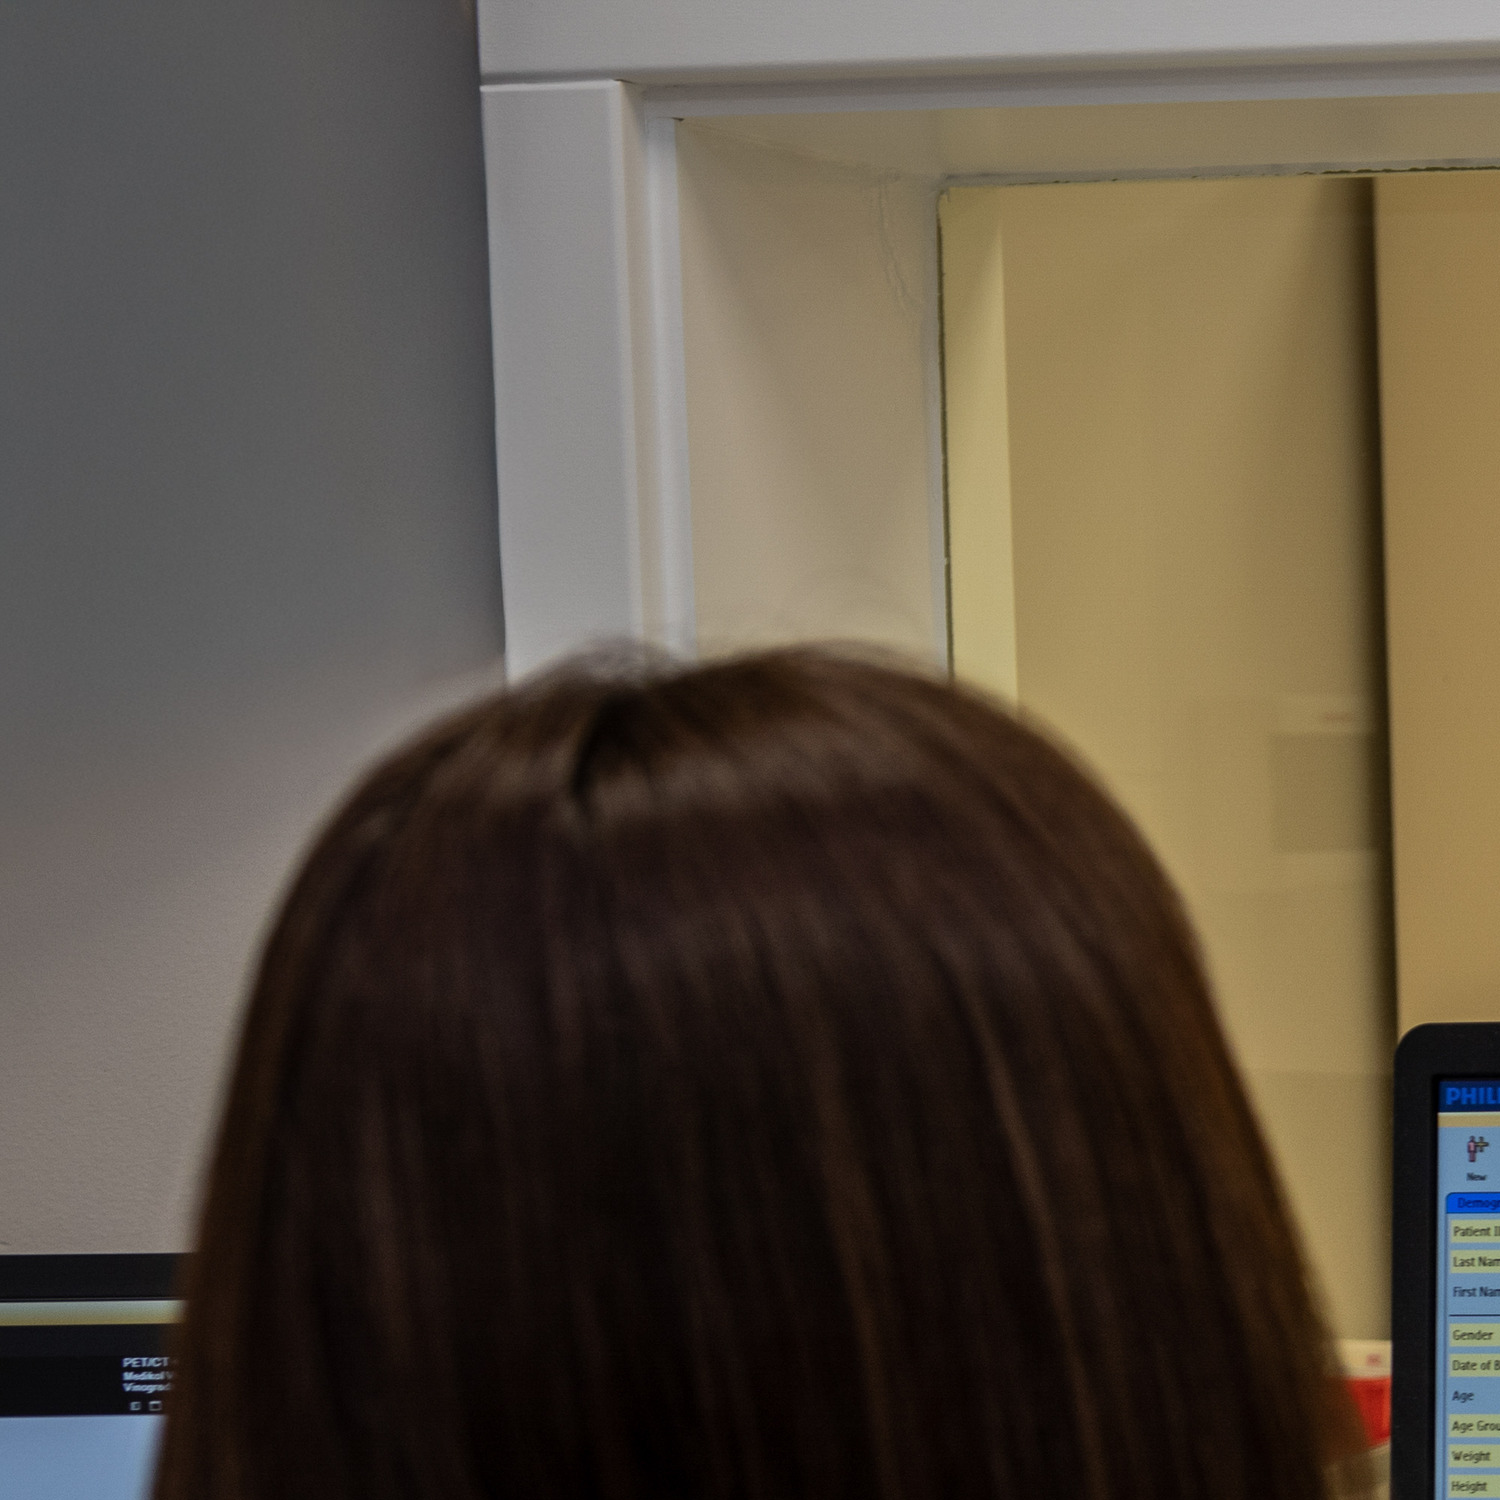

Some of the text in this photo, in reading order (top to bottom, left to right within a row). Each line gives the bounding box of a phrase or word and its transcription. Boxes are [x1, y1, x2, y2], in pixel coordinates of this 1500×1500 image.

[1467, 1172, 1486, 1181] New
[1453, 1226, 1491, 1237] Patient
[1453, 1256, 1475, 1268] Last
[1453, 1286, 1477, 1298] First
[1452, 1329, 1494, 1341] Gender
[1452, 1360, 1478, 1371] Date
[1480, 1360, 1491, 1371] of
[1452, 1390, 1475, 1403] Age
[1452, 1420, 1474, 1433] Age
[1451, 1450, 1491, 1464] Weight
[1451, 1481, 1488, 1494] Height
